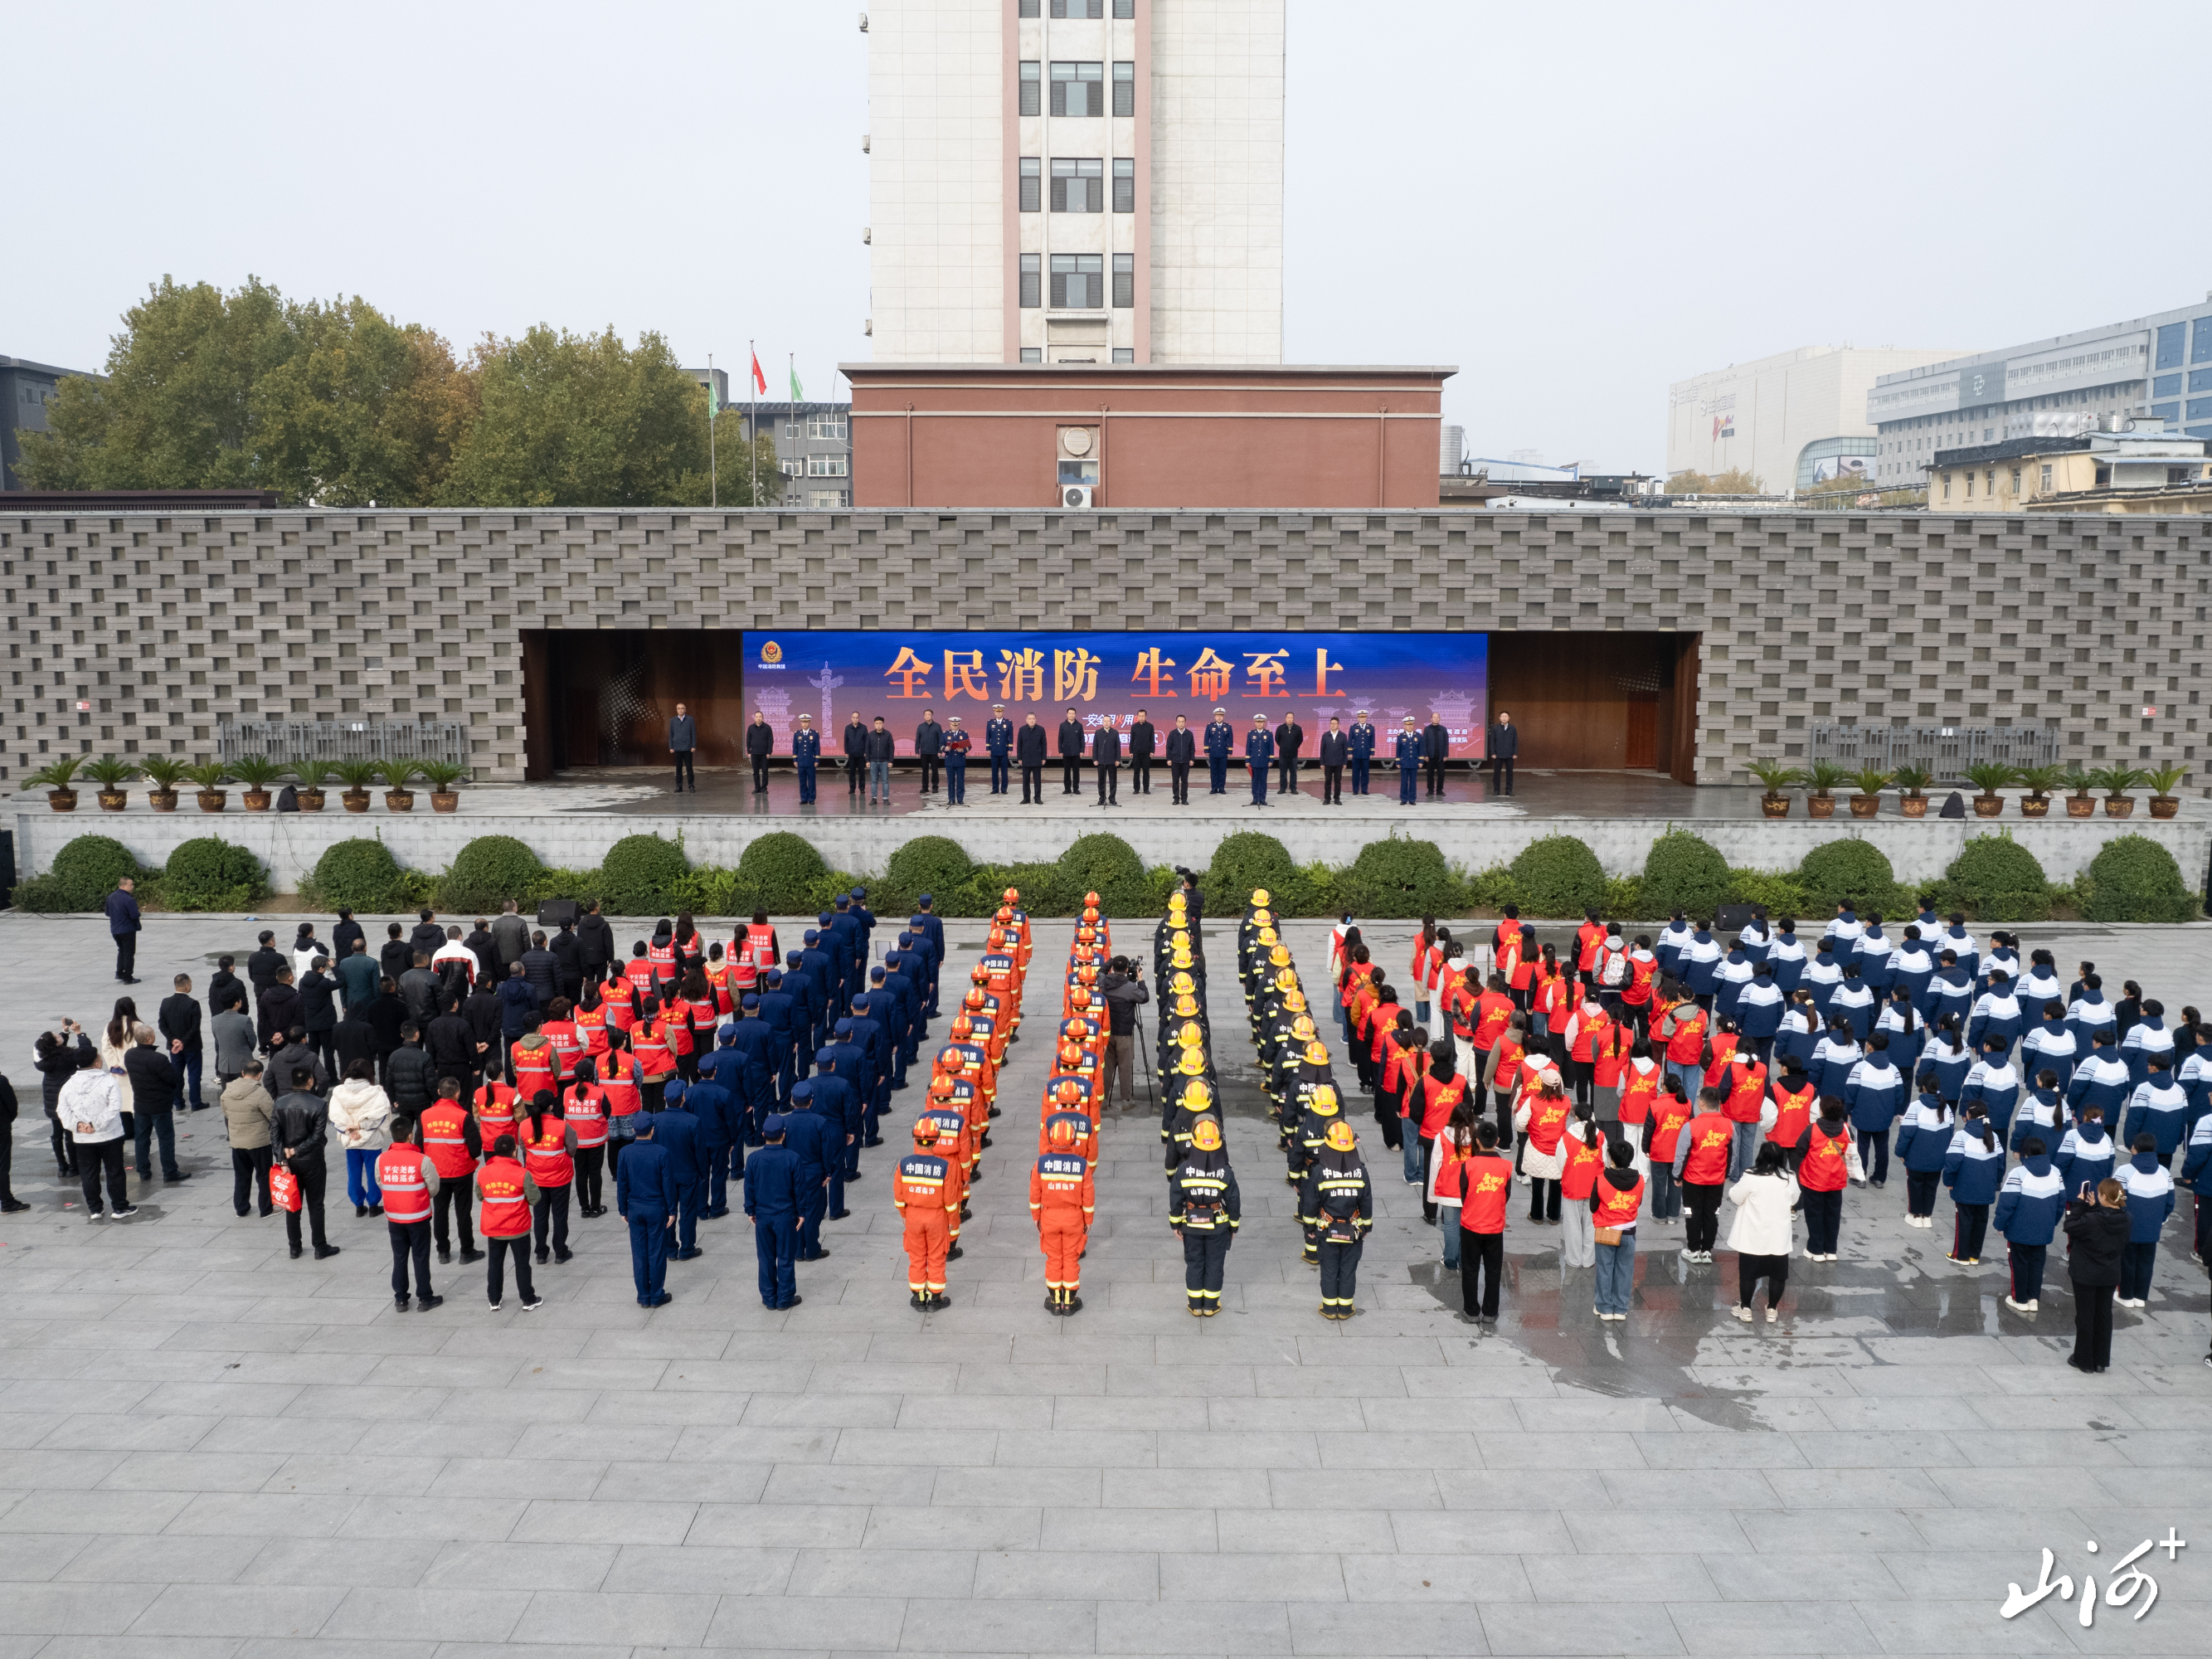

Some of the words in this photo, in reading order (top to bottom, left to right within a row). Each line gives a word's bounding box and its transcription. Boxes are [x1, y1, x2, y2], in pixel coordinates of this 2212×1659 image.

[884, 647, 1101, 702] 全民消防
[1130, 647, 1347, 702] 生命至上
[975, 1024, 989, 1033] 消防
[962, 1051, 977, 1061] 消防
[955, 1087, 969, 1097] 消防
[934, 1117, 960, 1129] 国消防
[384, 1165, 416, 1175] 平安尧都
[907, 1163, 942, 1177] 中国消防
[1044, 1160, 1082, 1173] 中国消防
[383, 1175, 416, 1183] 网格巡查
[909, 1186, 936, 1194] 山西临汾
[1048, 1182, 1076, 1191] 山西临汾
[1190, 1188, 1218, 1197] 山西临汾
[1330, 1188, 1359, 1197] 山西临汾
